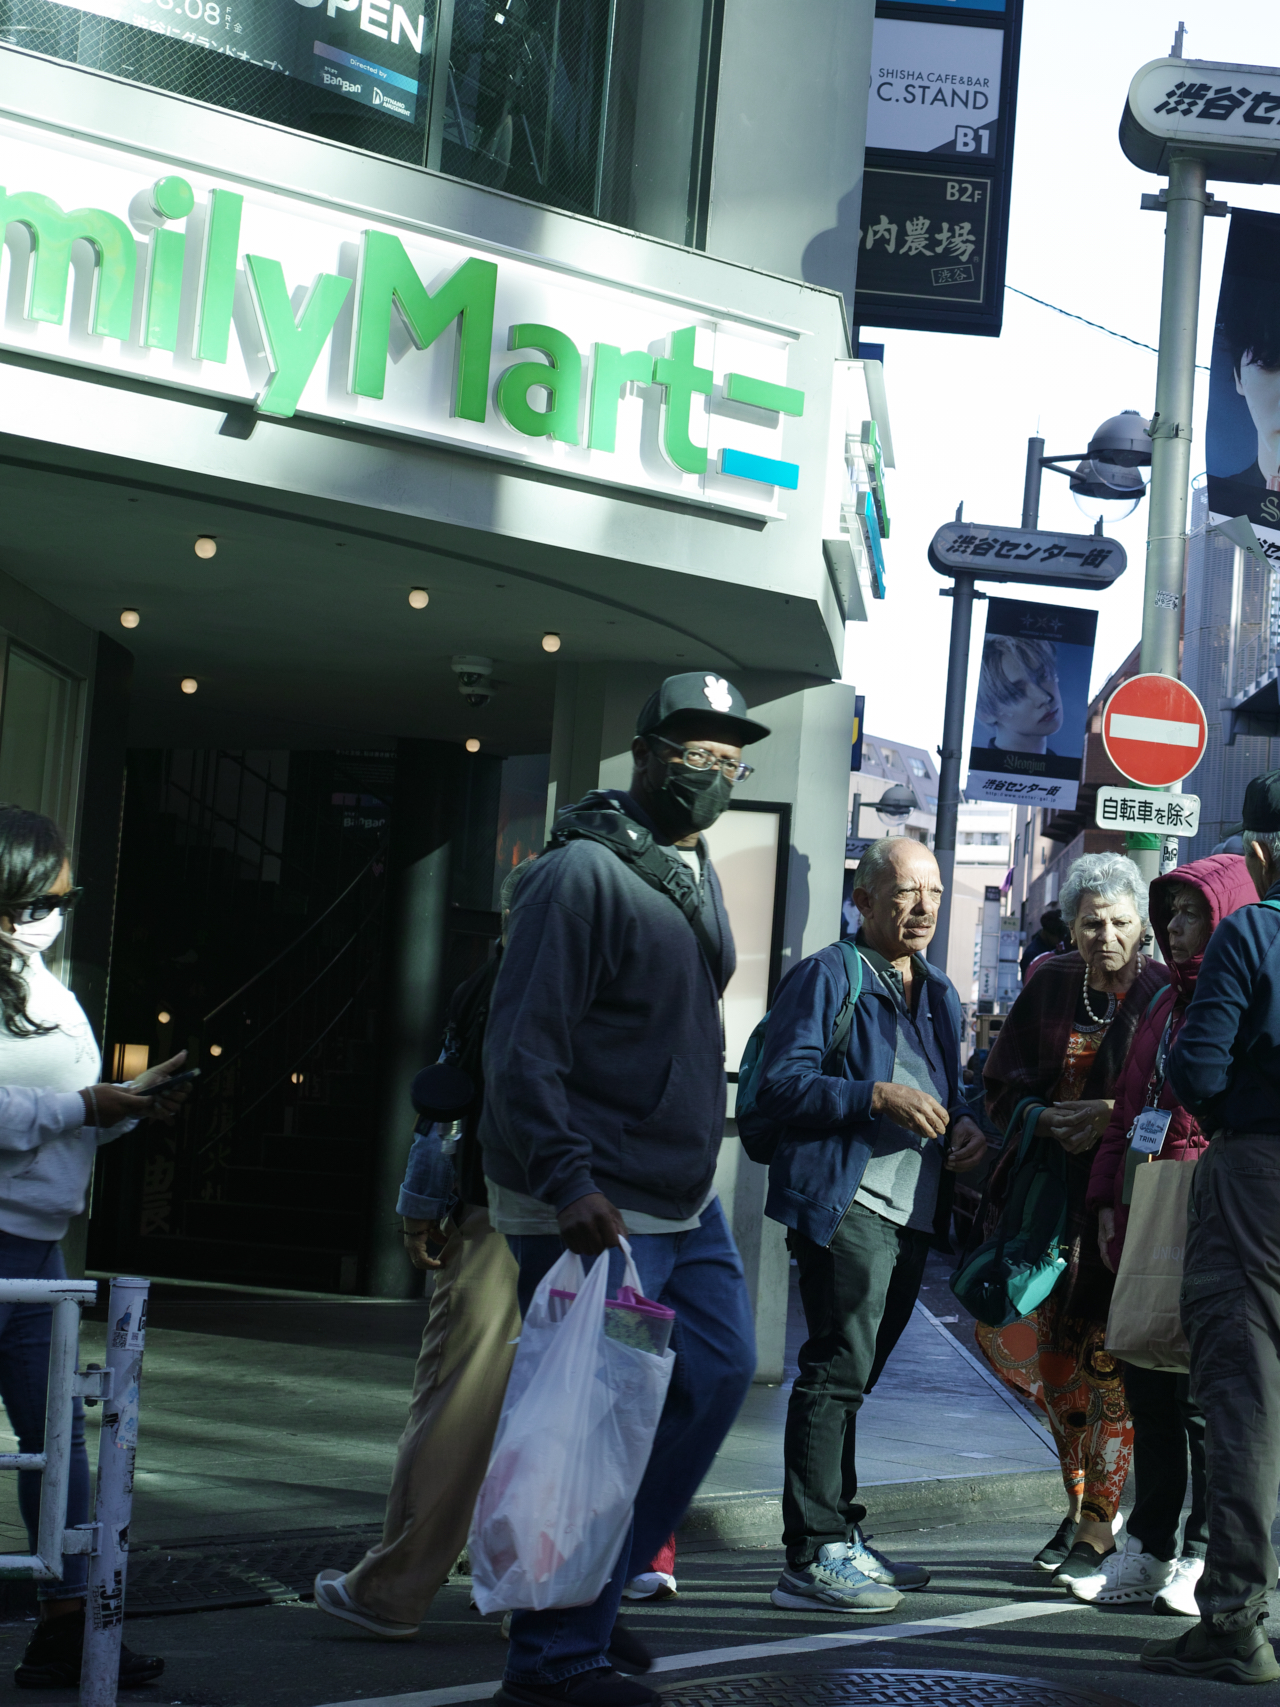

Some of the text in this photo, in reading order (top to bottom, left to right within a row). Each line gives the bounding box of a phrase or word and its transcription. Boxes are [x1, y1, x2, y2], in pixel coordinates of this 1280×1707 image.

[350, 58, 377, 74] Directed
[379, 70, 388, 79] by
[878, 67, 990, 88] SHISHA CAFE&BAR
[323, 73, 361, 93] BanBan
[876, 82, 989, 110] C.STAND
[956, 126, 990, 154] B1
[946, 181, 982, 203] B2F
[860, 214, 976, 263] 内農場
[937, 267, 967, 284] 渋谷
[946, 535, 1113, 568] 渋谷センター街
[982, 779, 1062, 797] 渋谷センター街
[1102, 796, 1194, 828] 自転車を除く
[1139, 1134, 1157, 1145] TRINI
